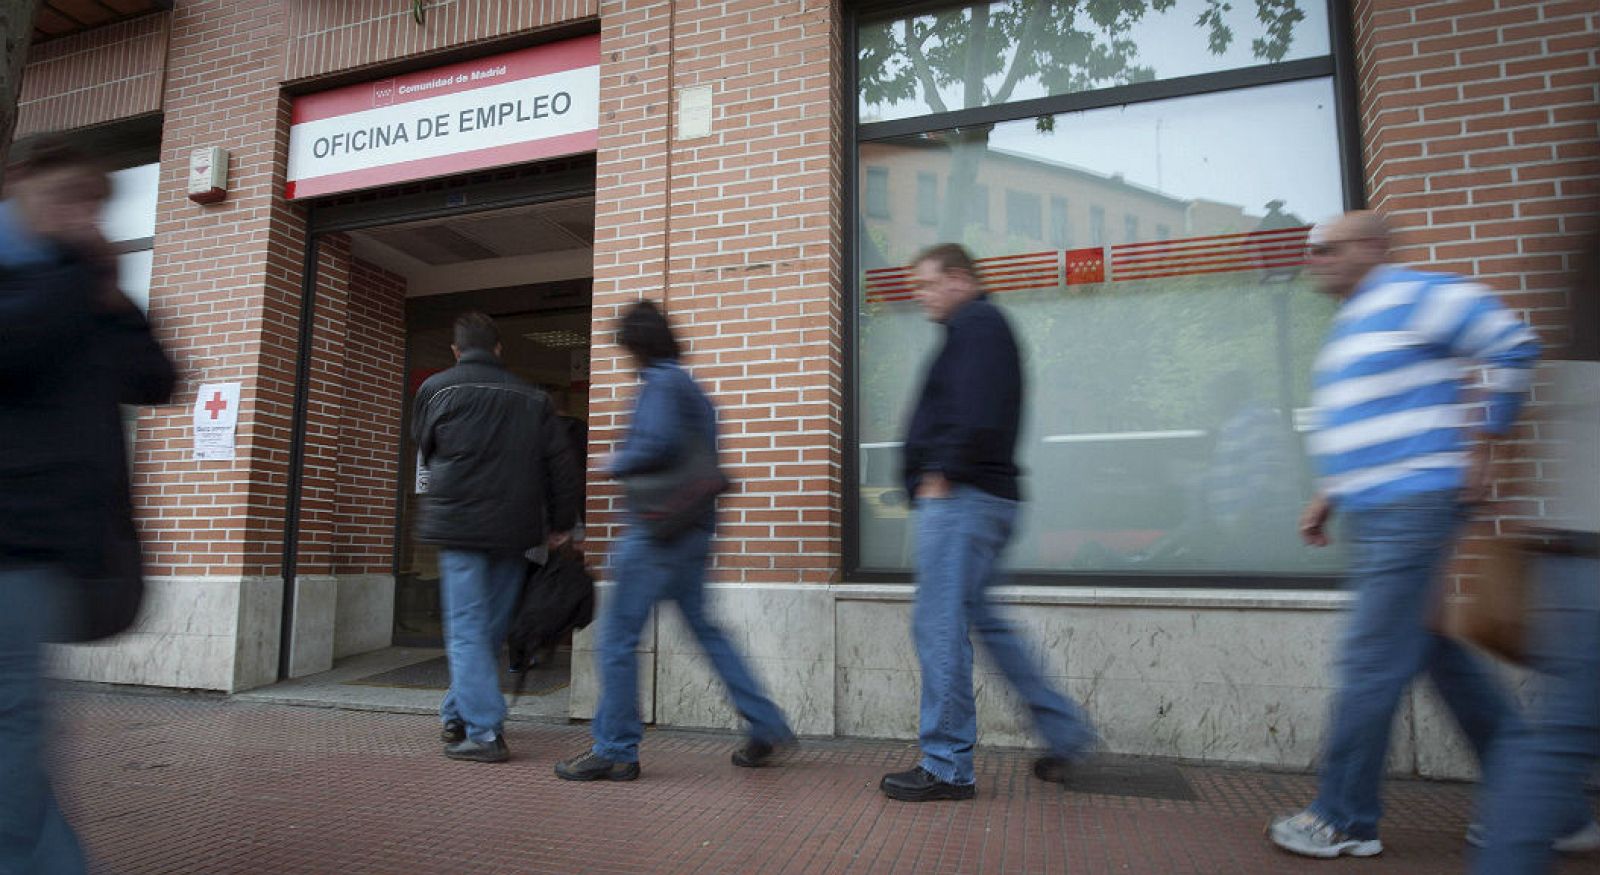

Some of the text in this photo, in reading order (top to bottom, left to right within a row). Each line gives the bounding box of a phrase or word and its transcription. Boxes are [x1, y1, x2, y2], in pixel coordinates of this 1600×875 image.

[398, 65, 506, 94] Comunidad de Madrid
[313, 91, 572, 158] OFICINA DE EMPLEO
